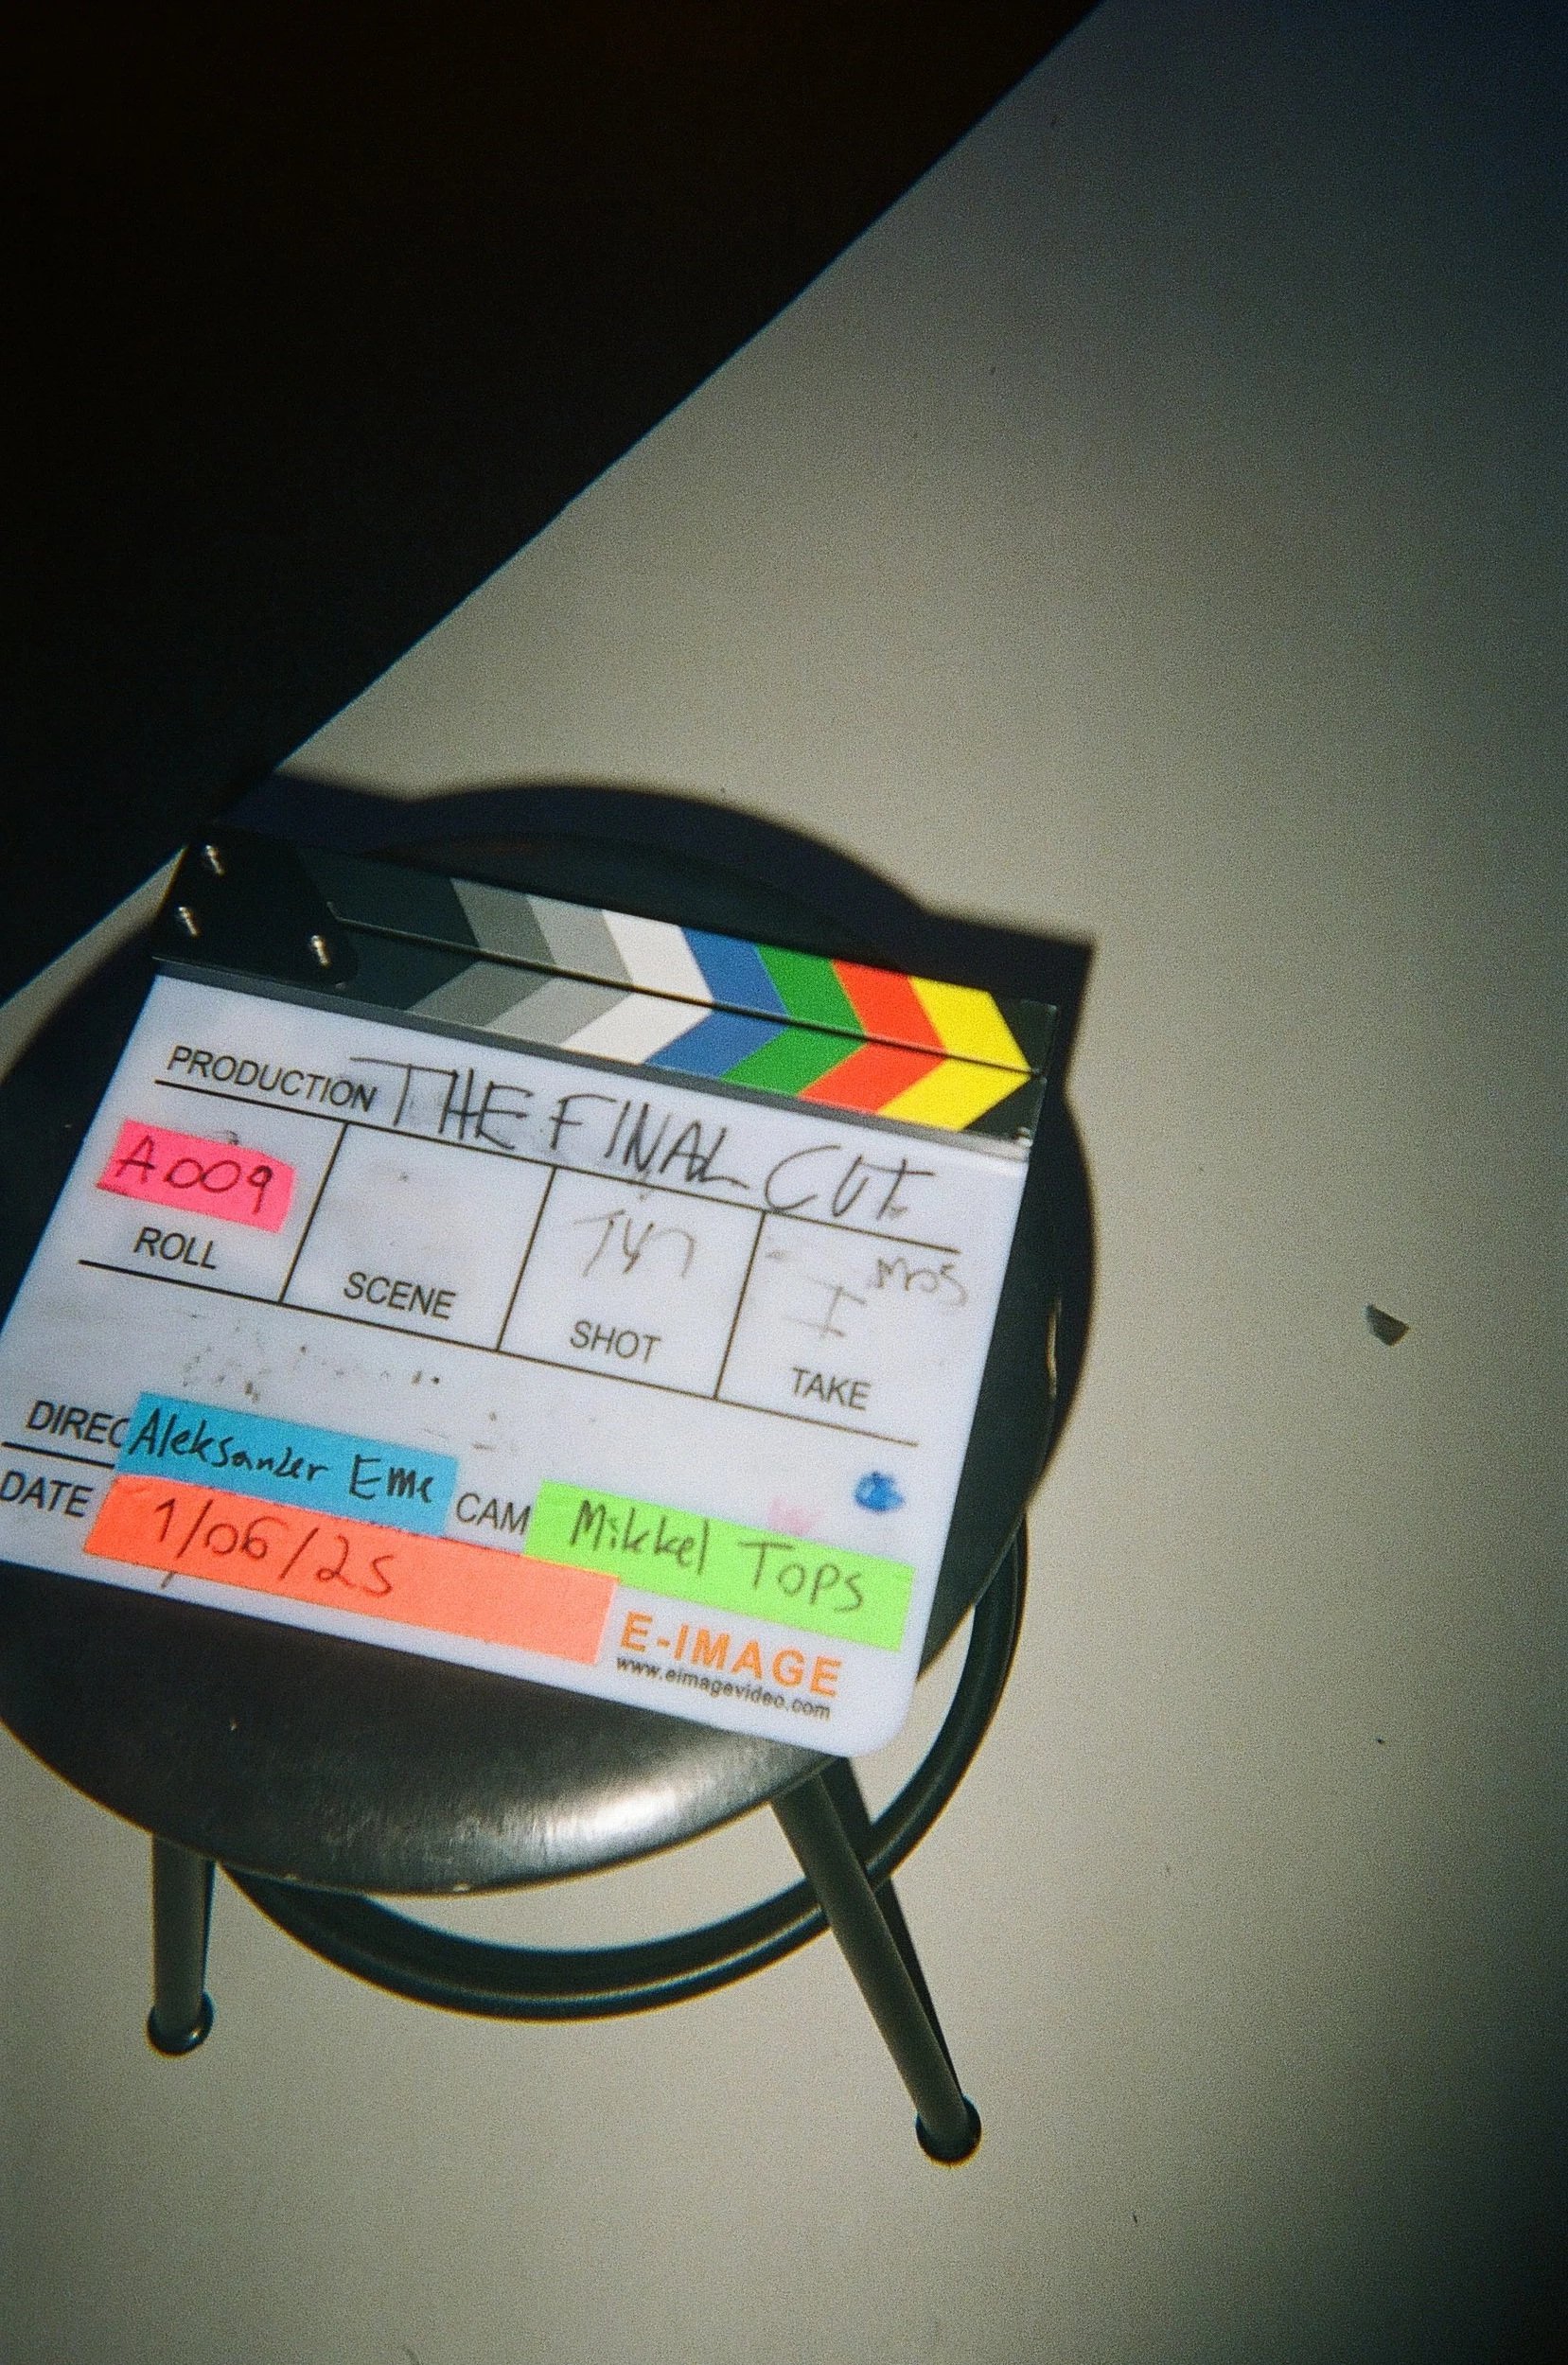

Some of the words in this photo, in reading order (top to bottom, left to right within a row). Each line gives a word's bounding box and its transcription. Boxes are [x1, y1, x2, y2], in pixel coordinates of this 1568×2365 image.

[167, 1046, 378, 1113] PRODUCTION
[350, 1057, 534, 1149] THE
[549, 1094, 749, 1190] FINAL
[765, 1144, 936, 1221] CUT
[115, 1137, 273, 1213] A009
[133, 1227, 217, 1269] ROLL
[344, 1271, 456, 1320] SCENE
[569, 1319, 661, 1364] SHOT
[791, 1366, 872, 1411] TAKE
[0, 1470, 93, 1518] DATE
[569, 1499, 710, 1575] Mikkel
[615, 1654, 831, 1721] www.eimagevideo.com
[619, 1611, 843, 1699] E-IMAGE
